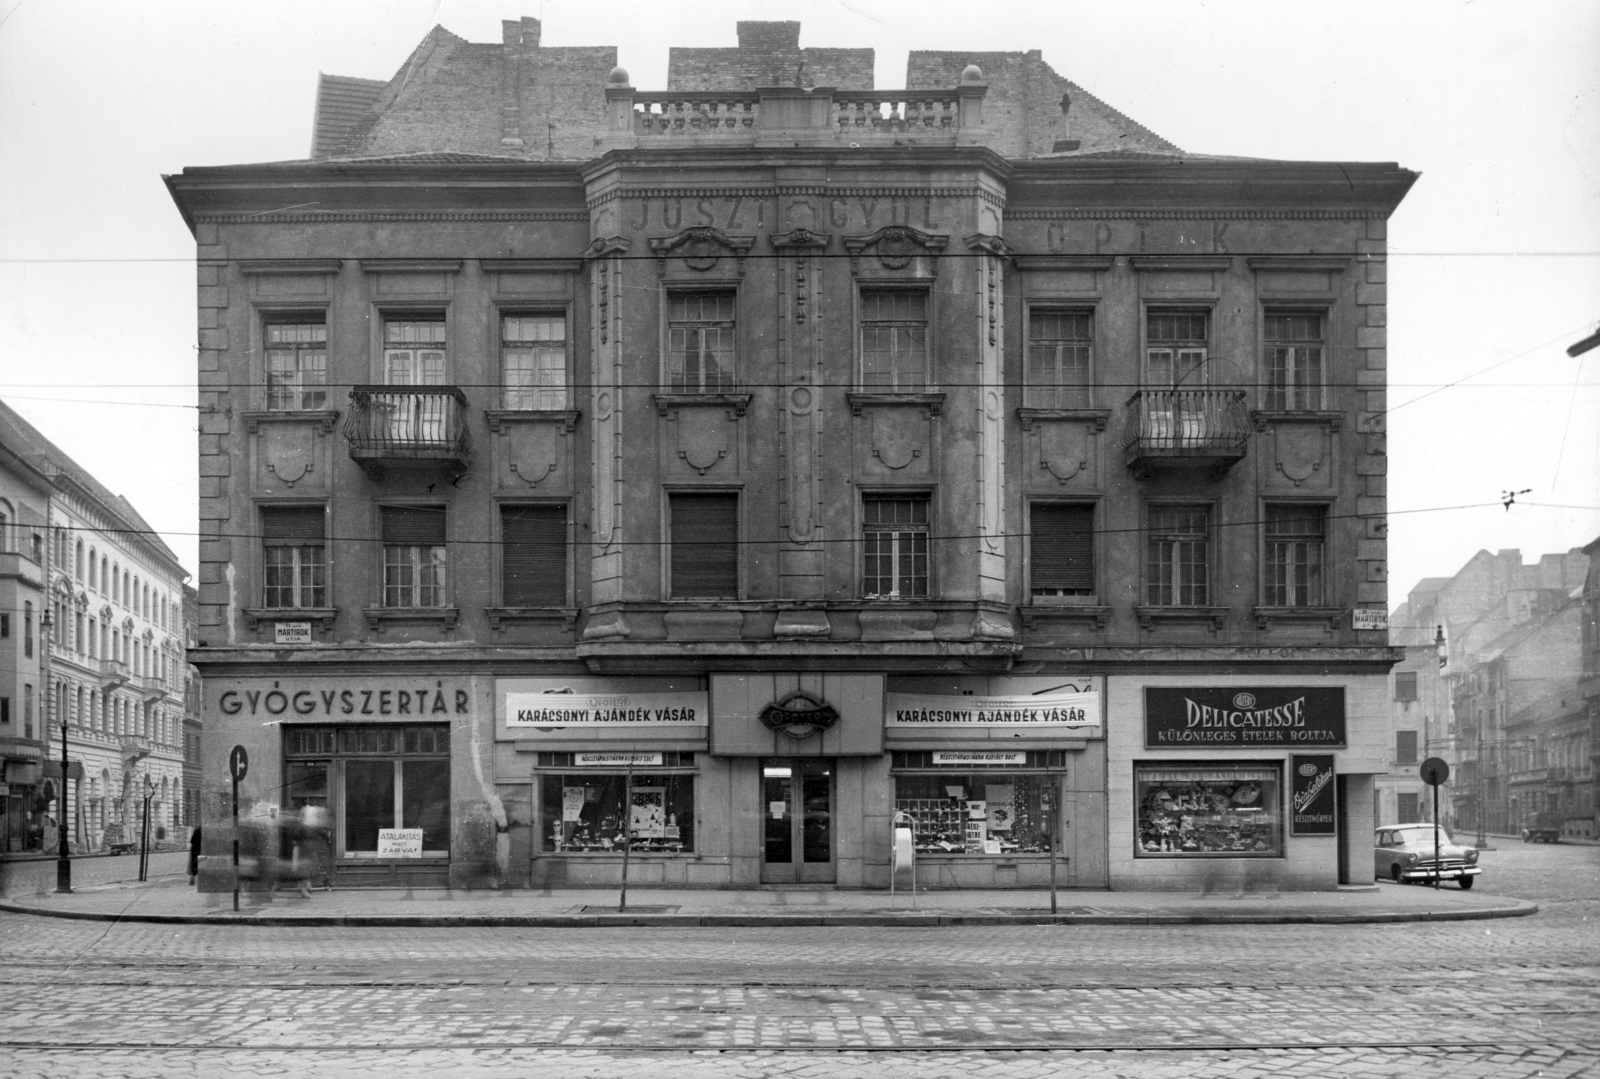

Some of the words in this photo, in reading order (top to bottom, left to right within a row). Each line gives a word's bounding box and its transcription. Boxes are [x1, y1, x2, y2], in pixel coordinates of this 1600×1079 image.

[219, 680, 469, 715] GYÓGYSZERTÁR
[517, 706, 589, 722] KARÁCSONYI
[593, 705, 651, 722] AJÁNDÉK
[655, 705, 696, 721] VÁSÁR
[896, 707, 972, 722] KARÁCSONYI
[977, 707, 1038, 722] AJÁNDÉK
[1042, 706, 1086, 722] VÁSÁR
[1184, 696, 1306, 728] DELICATESSE
[1158, 728, 1237, 741] KÜLÖNLEGES
[1242, 727, 1285, 741] ÉTELEK
[1289, 730, 1336, 741] BOLTJA
[382, 846, 418, 854] ZÁRVA!
